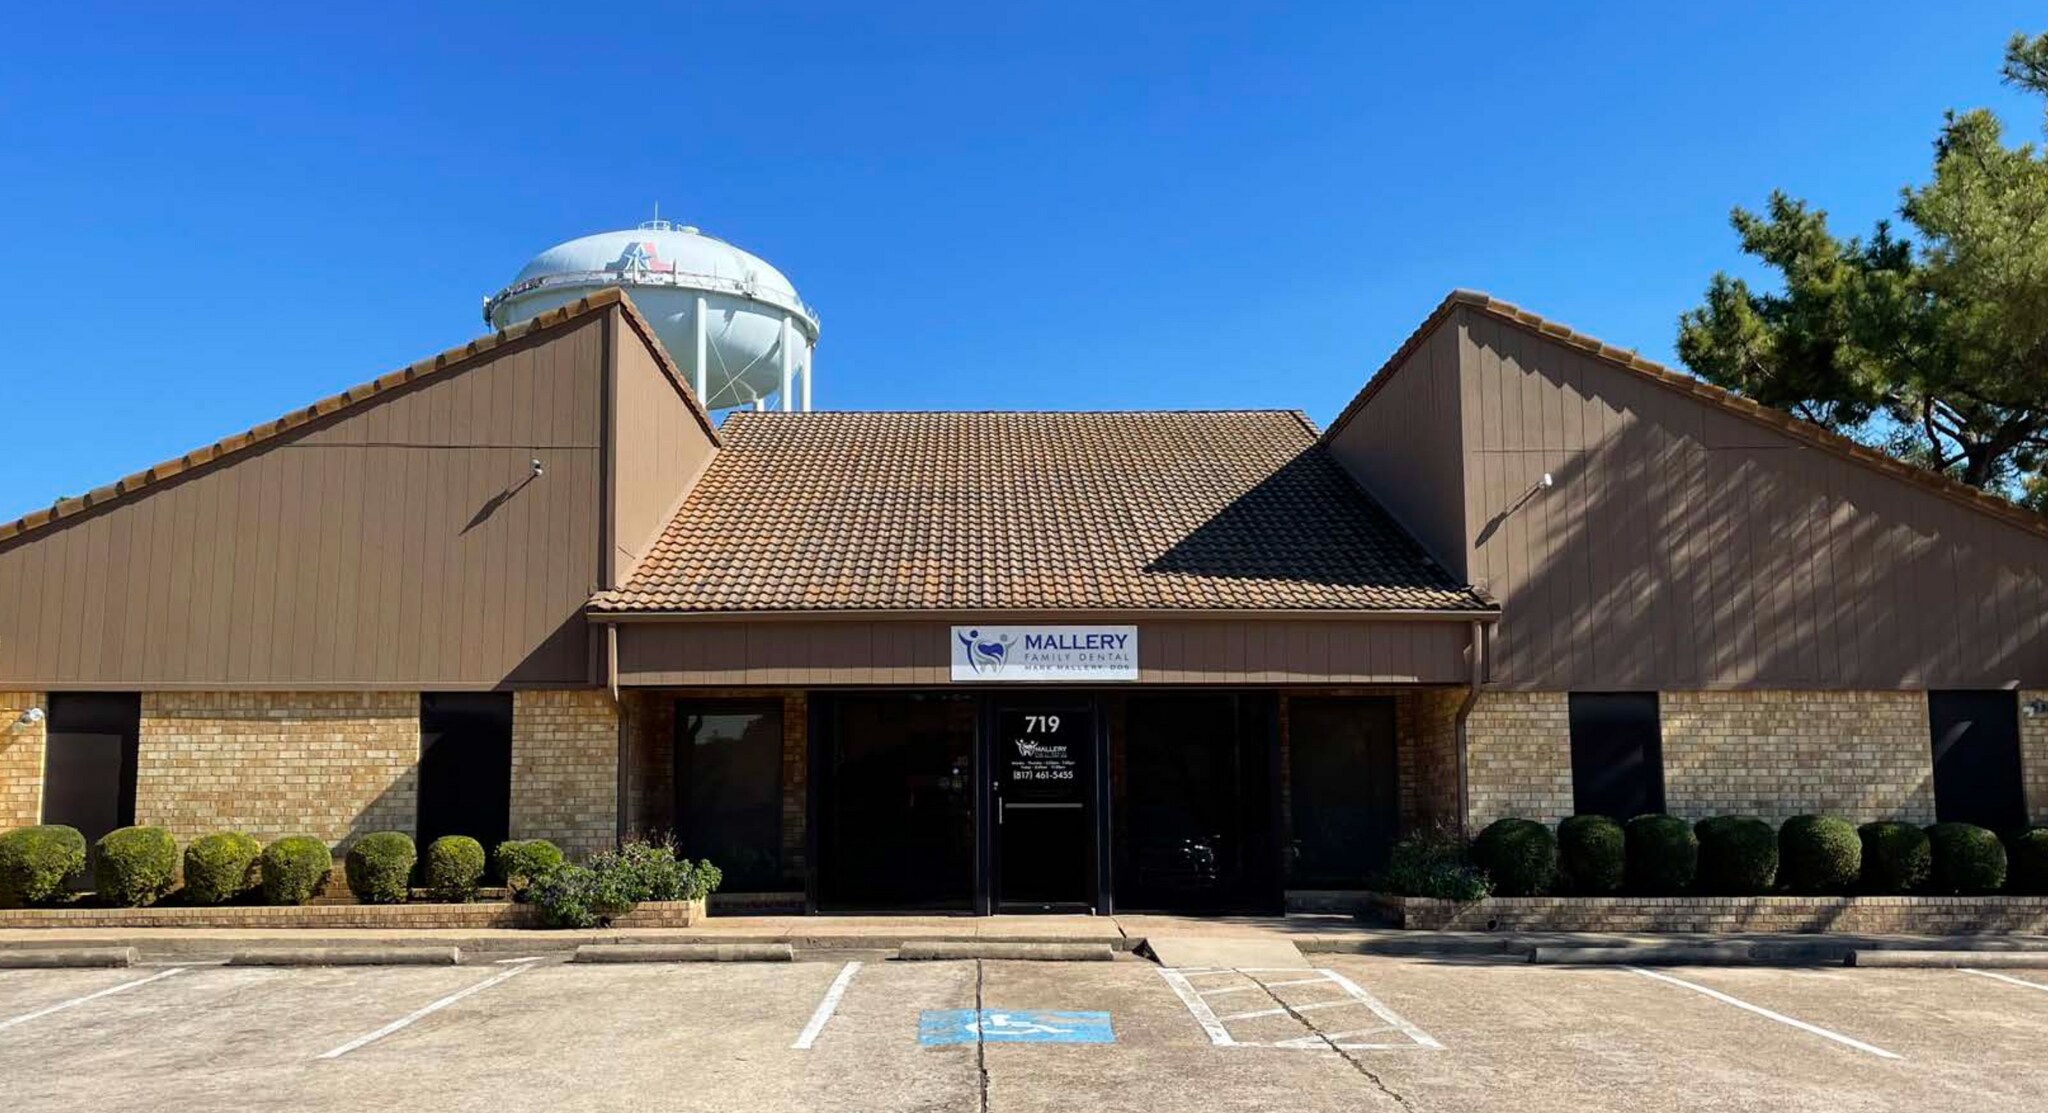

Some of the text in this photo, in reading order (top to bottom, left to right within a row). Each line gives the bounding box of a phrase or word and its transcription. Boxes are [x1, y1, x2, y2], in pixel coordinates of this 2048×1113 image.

[1025, 634, 1128, 650] MALLERY
[1024, 653, 1129, 662] FAMILY DENTAL
[1025, 715, 1060, 733] 719
[1013, 770, 1074, 780] (817) 461-5455
